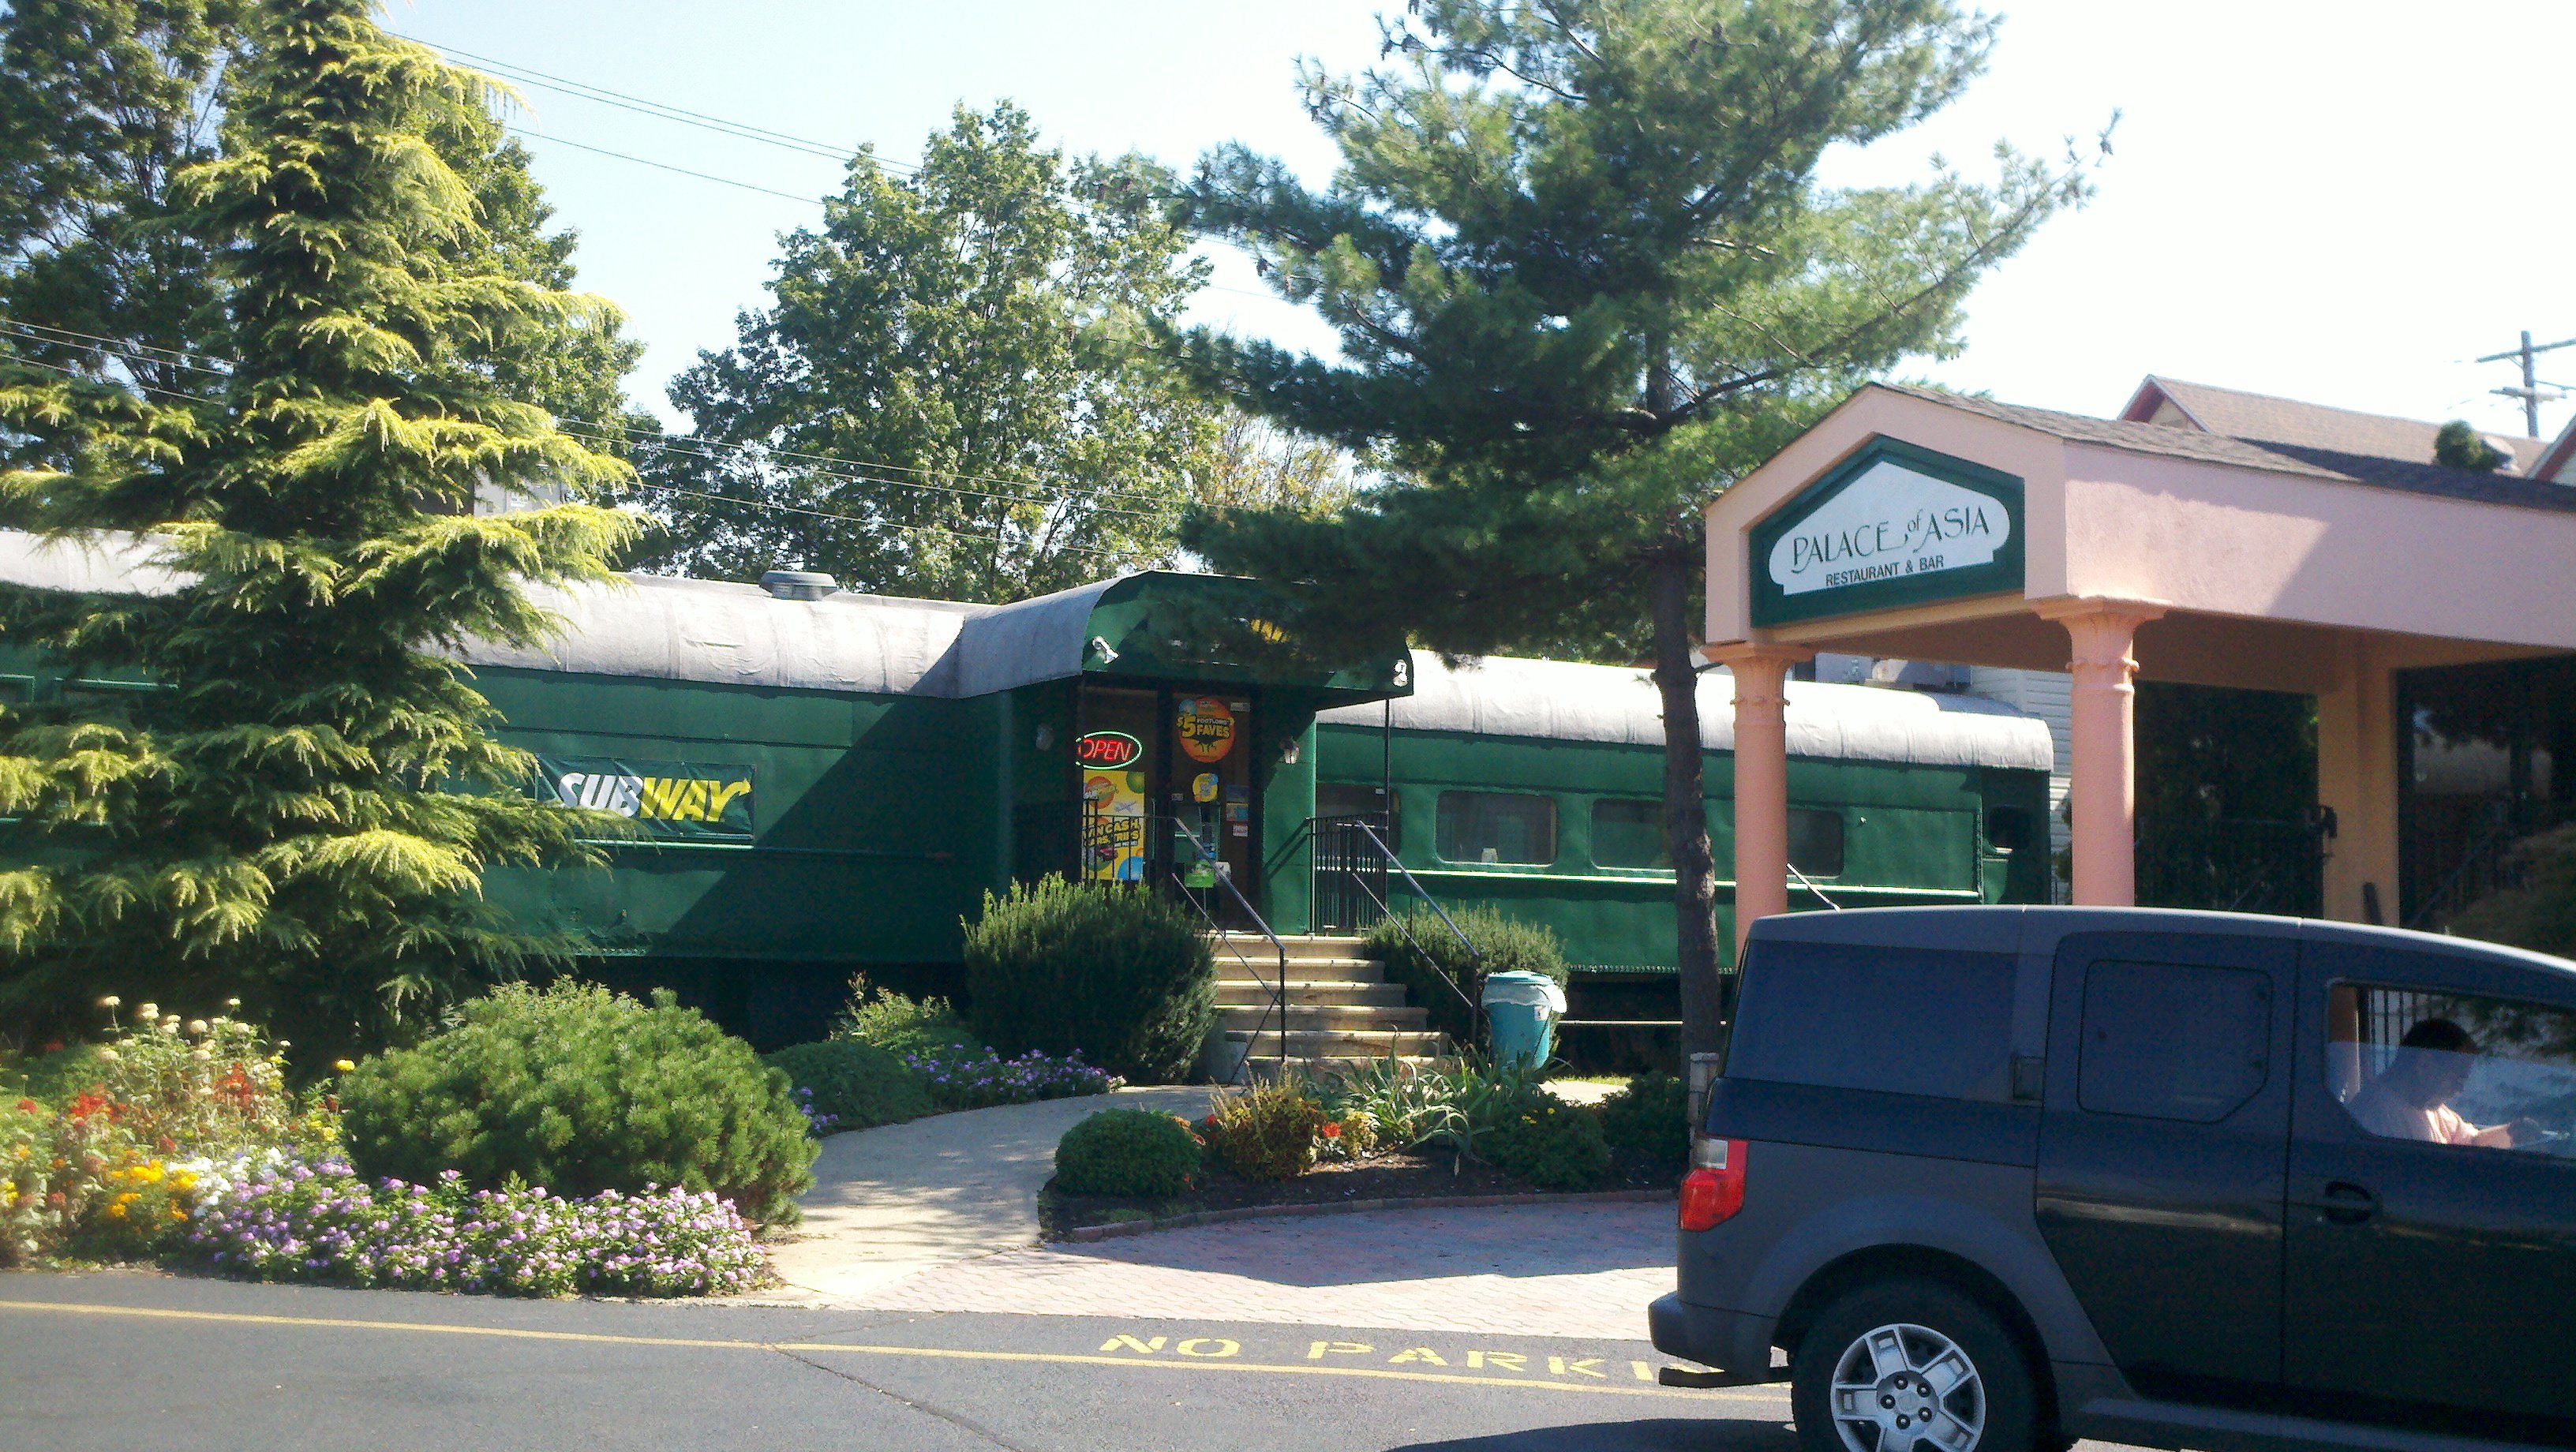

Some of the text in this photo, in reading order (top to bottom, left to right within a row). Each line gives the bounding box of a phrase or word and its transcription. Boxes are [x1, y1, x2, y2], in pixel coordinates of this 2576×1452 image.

[1791, 505, 1990, 574] PALACE of ASIA
[1825, 555, 1945, 587] RESTAURANT & BAR
[1077, 738, 1132, 761] OPEN
[1196, 724, 1230, 739] FAVES
[558, 772, 751, 822] SUBWAY
[1099, 1334, 1726, 1381] NO PARKI
